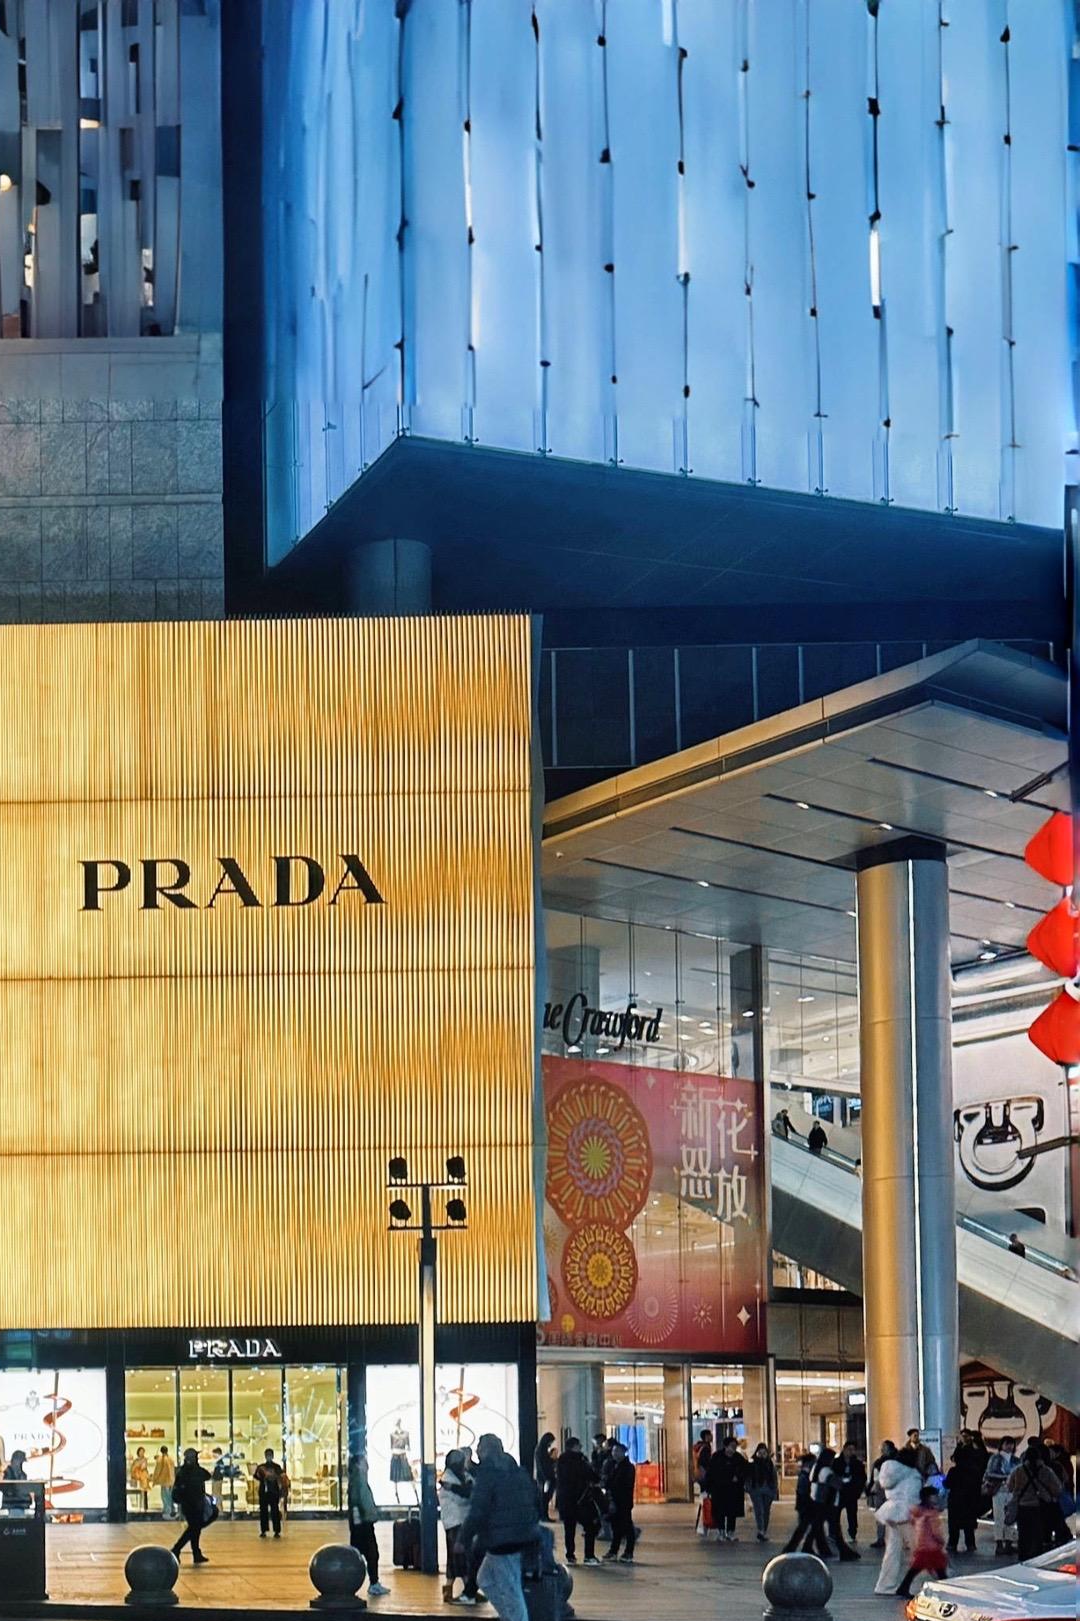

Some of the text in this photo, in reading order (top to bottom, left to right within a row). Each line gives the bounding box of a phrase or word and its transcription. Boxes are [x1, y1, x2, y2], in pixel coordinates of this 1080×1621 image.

[77, 854, 388, 911] PRADA
[562, 993, 663, 1051] Crawford
[188, 1339, 282, 1358] PRADA
